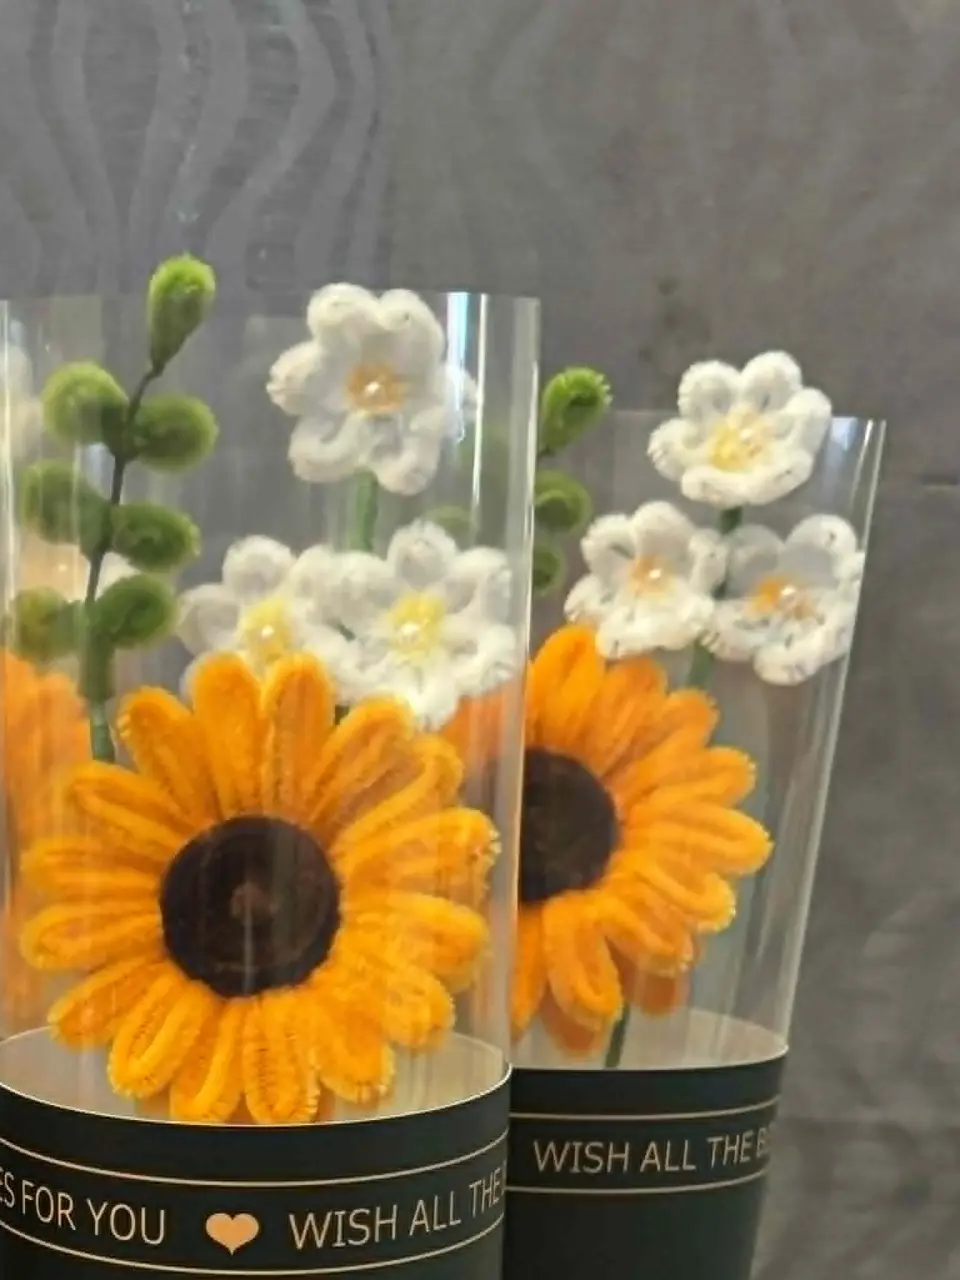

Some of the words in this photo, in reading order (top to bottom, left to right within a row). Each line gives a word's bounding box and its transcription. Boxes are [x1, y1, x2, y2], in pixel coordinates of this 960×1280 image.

[533, 1139, 630, 1174] WISH
[640, 1139, 697, 1173] ALL
[706, 1130, 754, 1167] THE
[21, 1179, 76, 1231] FOR
[86, 1198, 166, 1245] YOU
[288, 1204, 398, 1250] WISH
[409, 1190, 462, 1236] ALL
[468, 1166, 501, 1218] THE
